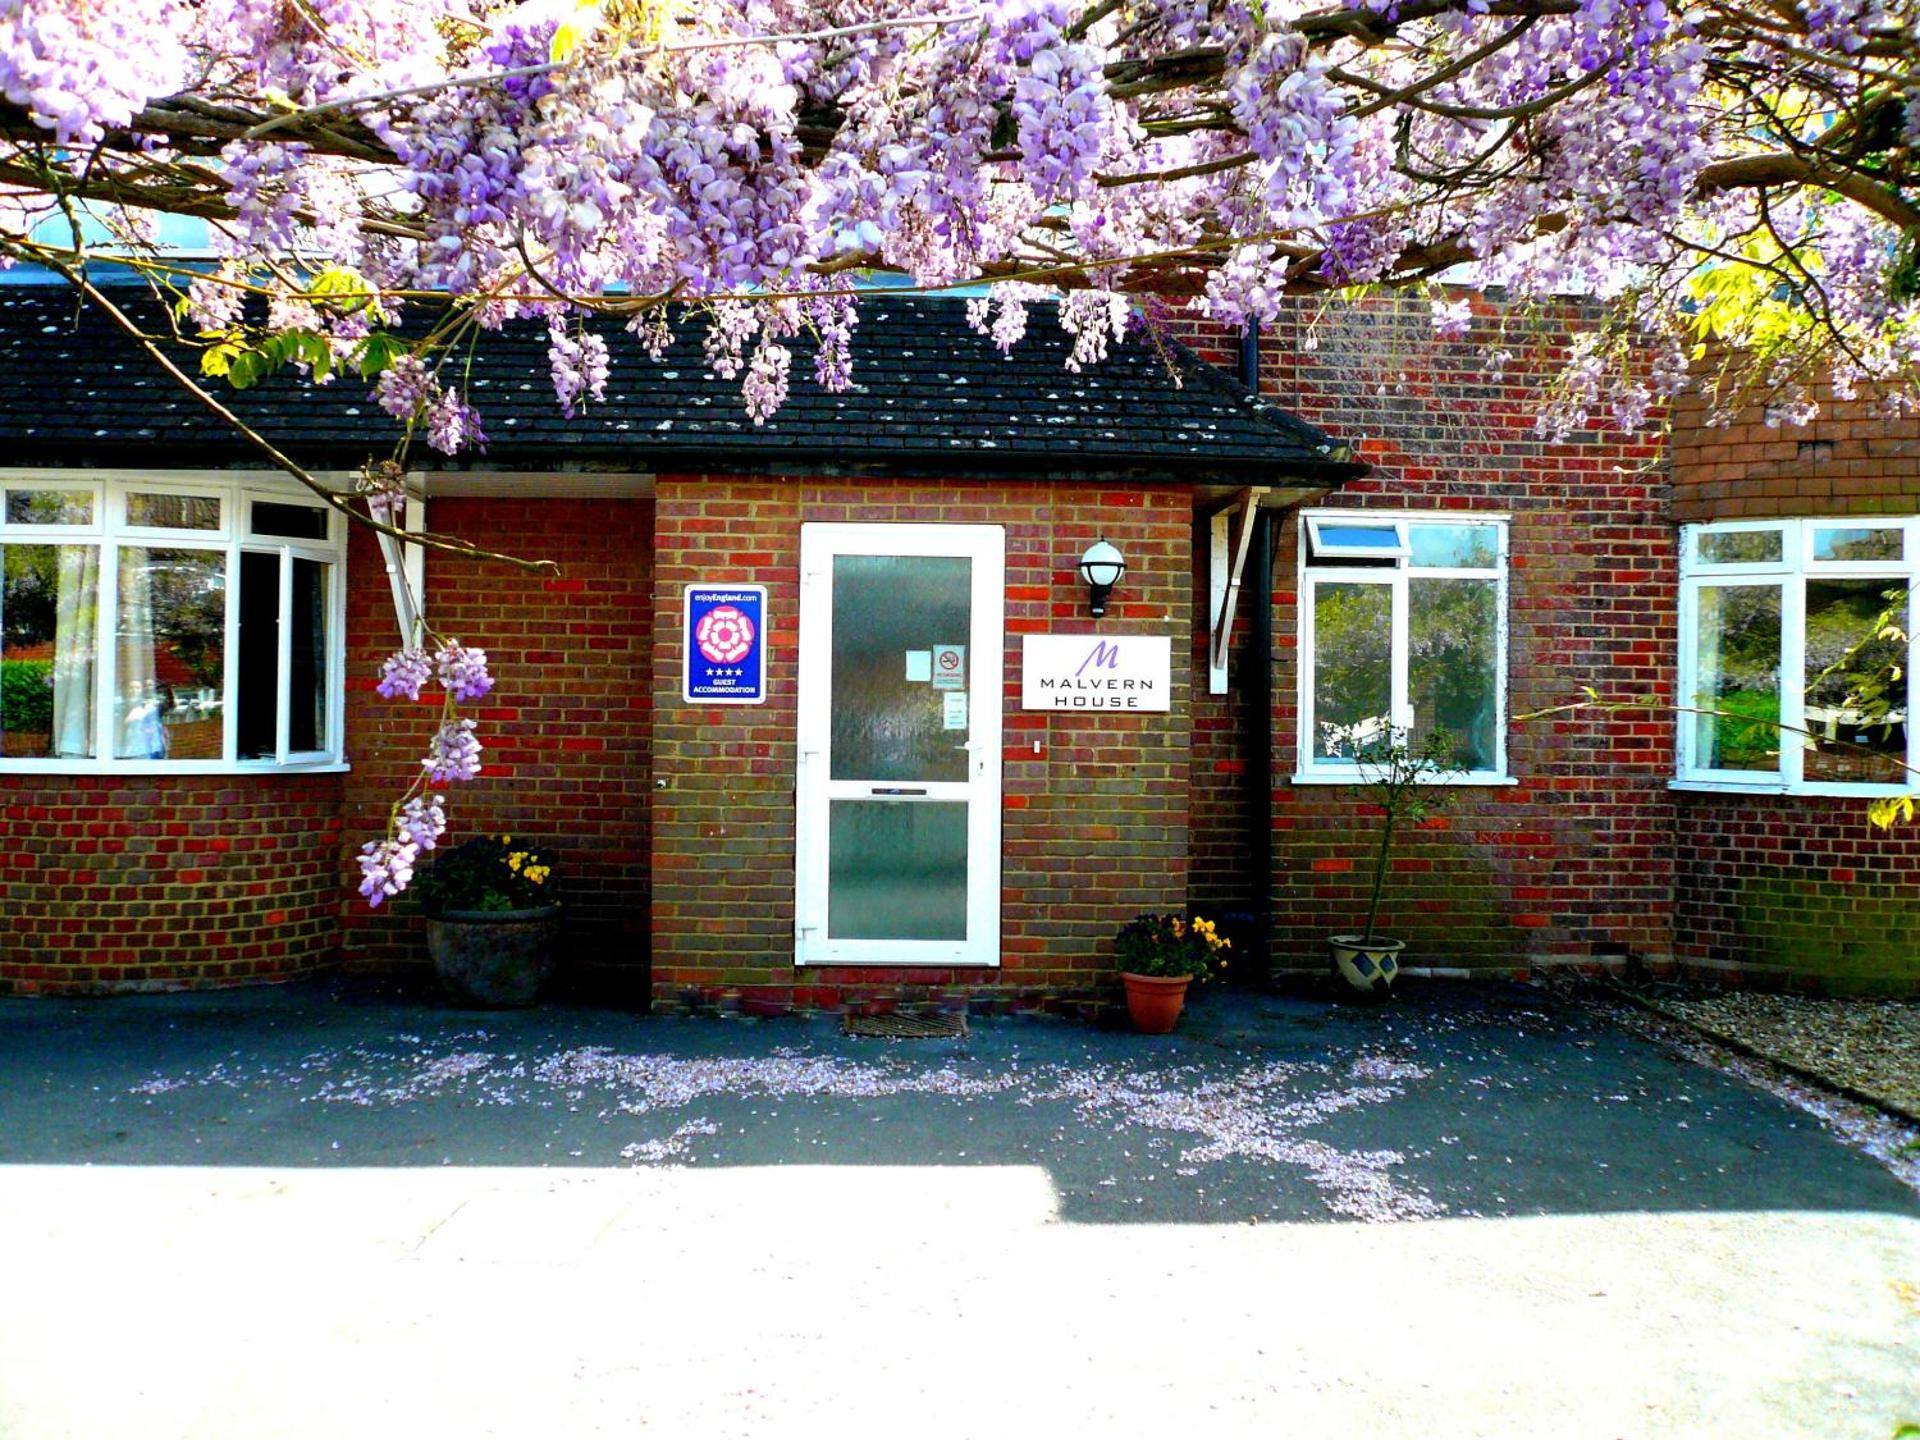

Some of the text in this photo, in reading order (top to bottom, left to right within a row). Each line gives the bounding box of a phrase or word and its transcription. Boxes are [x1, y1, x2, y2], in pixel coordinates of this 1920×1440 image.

[694, 593, 758, 603] enjoyEngland.com
[1040, 678, 1153, 690] MALVERN
[1055, 696, 1138, 707] HOUSE
